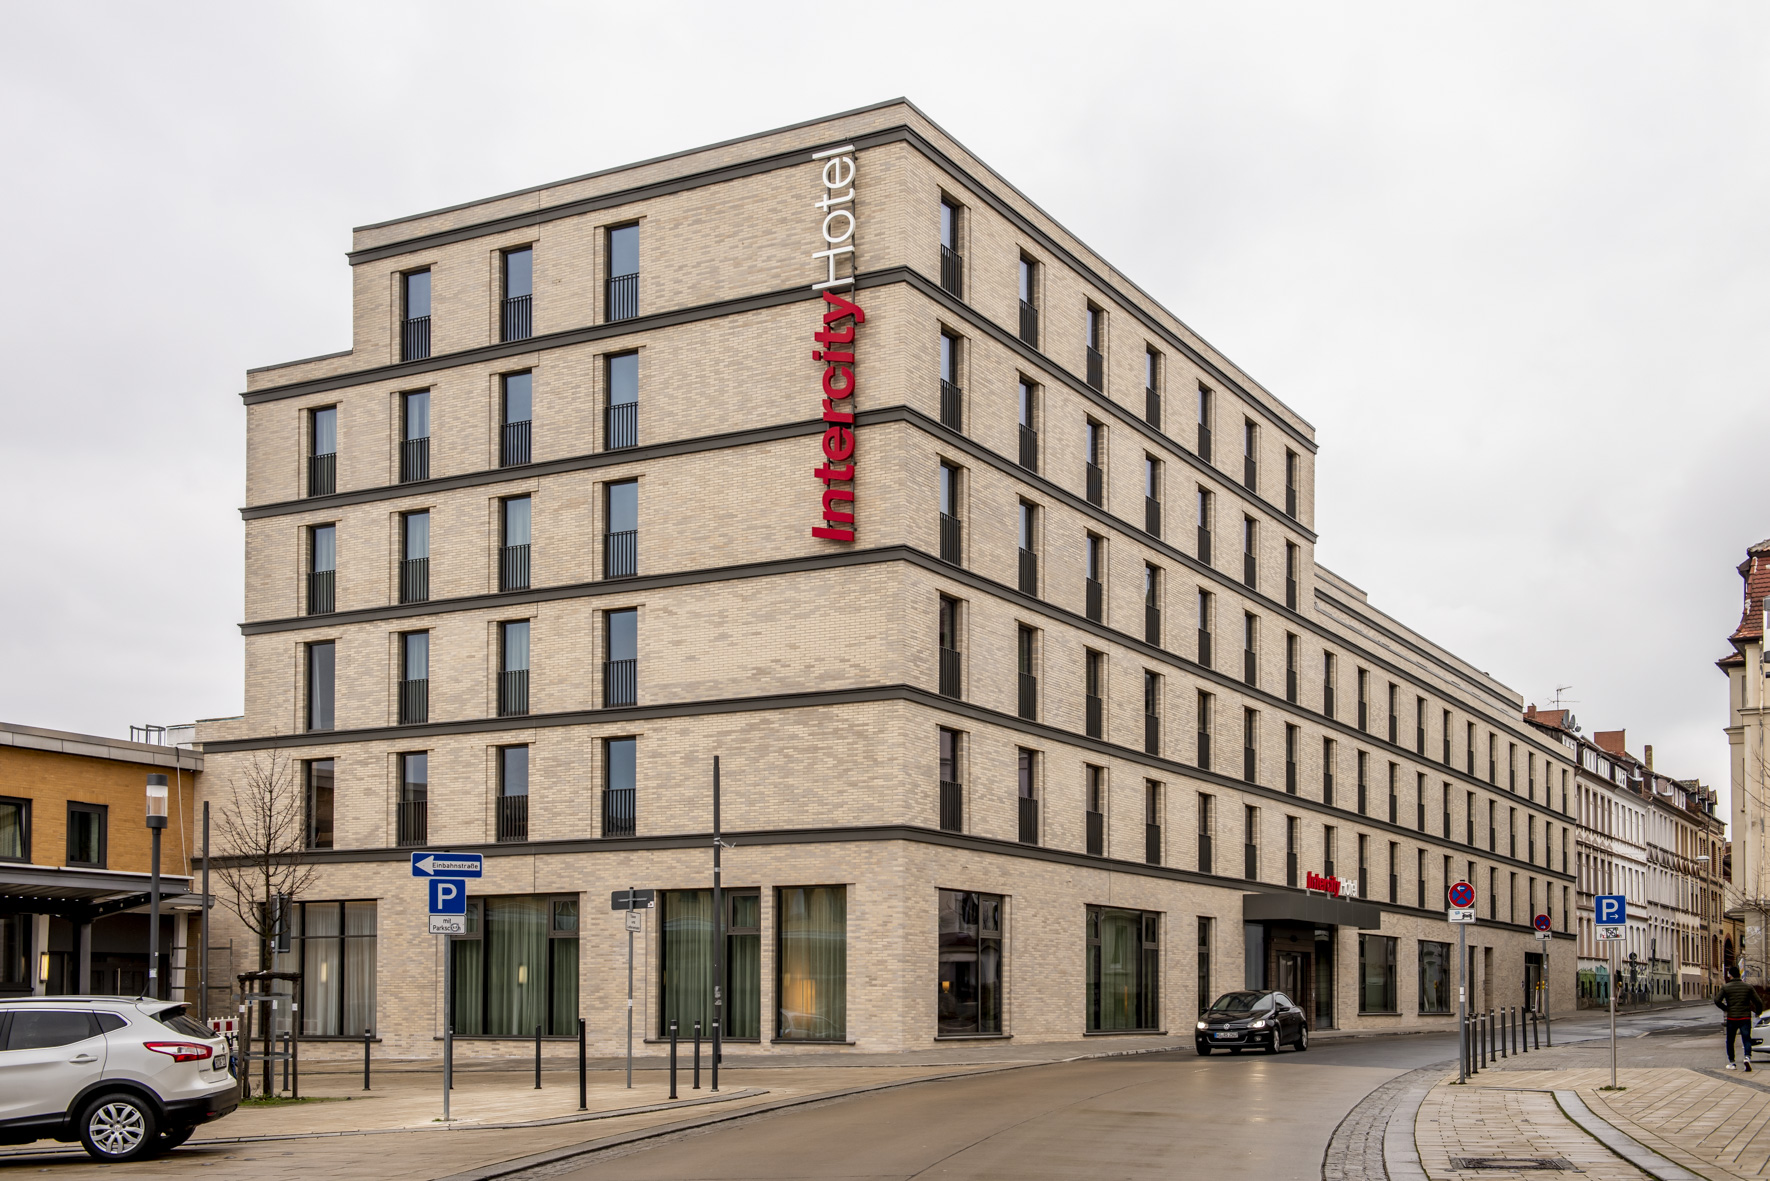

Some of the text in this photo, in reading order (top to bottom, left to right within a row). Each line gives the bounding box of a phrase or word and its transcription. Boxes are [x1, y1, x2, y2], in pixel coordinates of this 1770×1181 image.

[432, 862, 479, 870] Einbahnstraße
[437, 883, 457, 909] P
[1602, 899, 1619, 921] P
